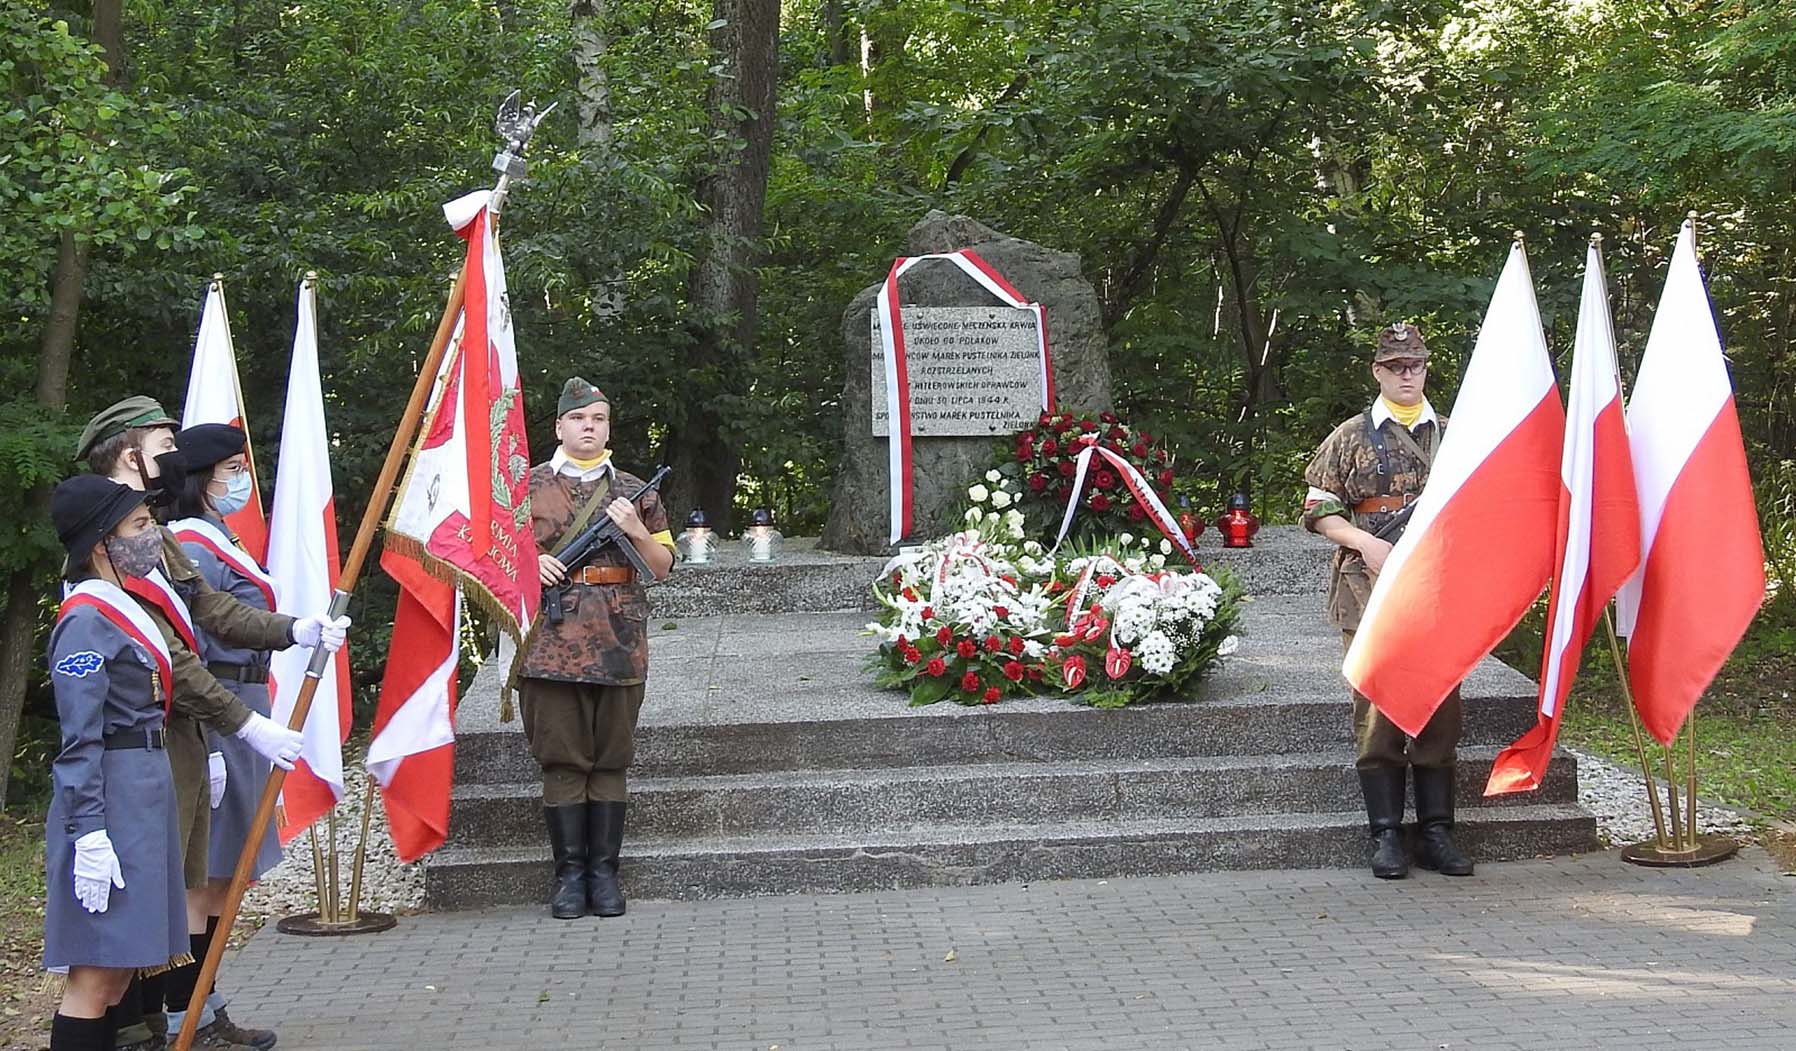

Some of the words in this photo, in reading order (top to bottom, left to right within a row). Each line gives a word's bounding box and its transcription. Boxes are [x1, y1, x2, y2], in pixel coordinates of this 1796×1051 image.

[939, 411, 967, 420] MAREK
[969, 411, 1021, 420] PUSTELNIKA
[490, 520, 518, 557] RMIA
